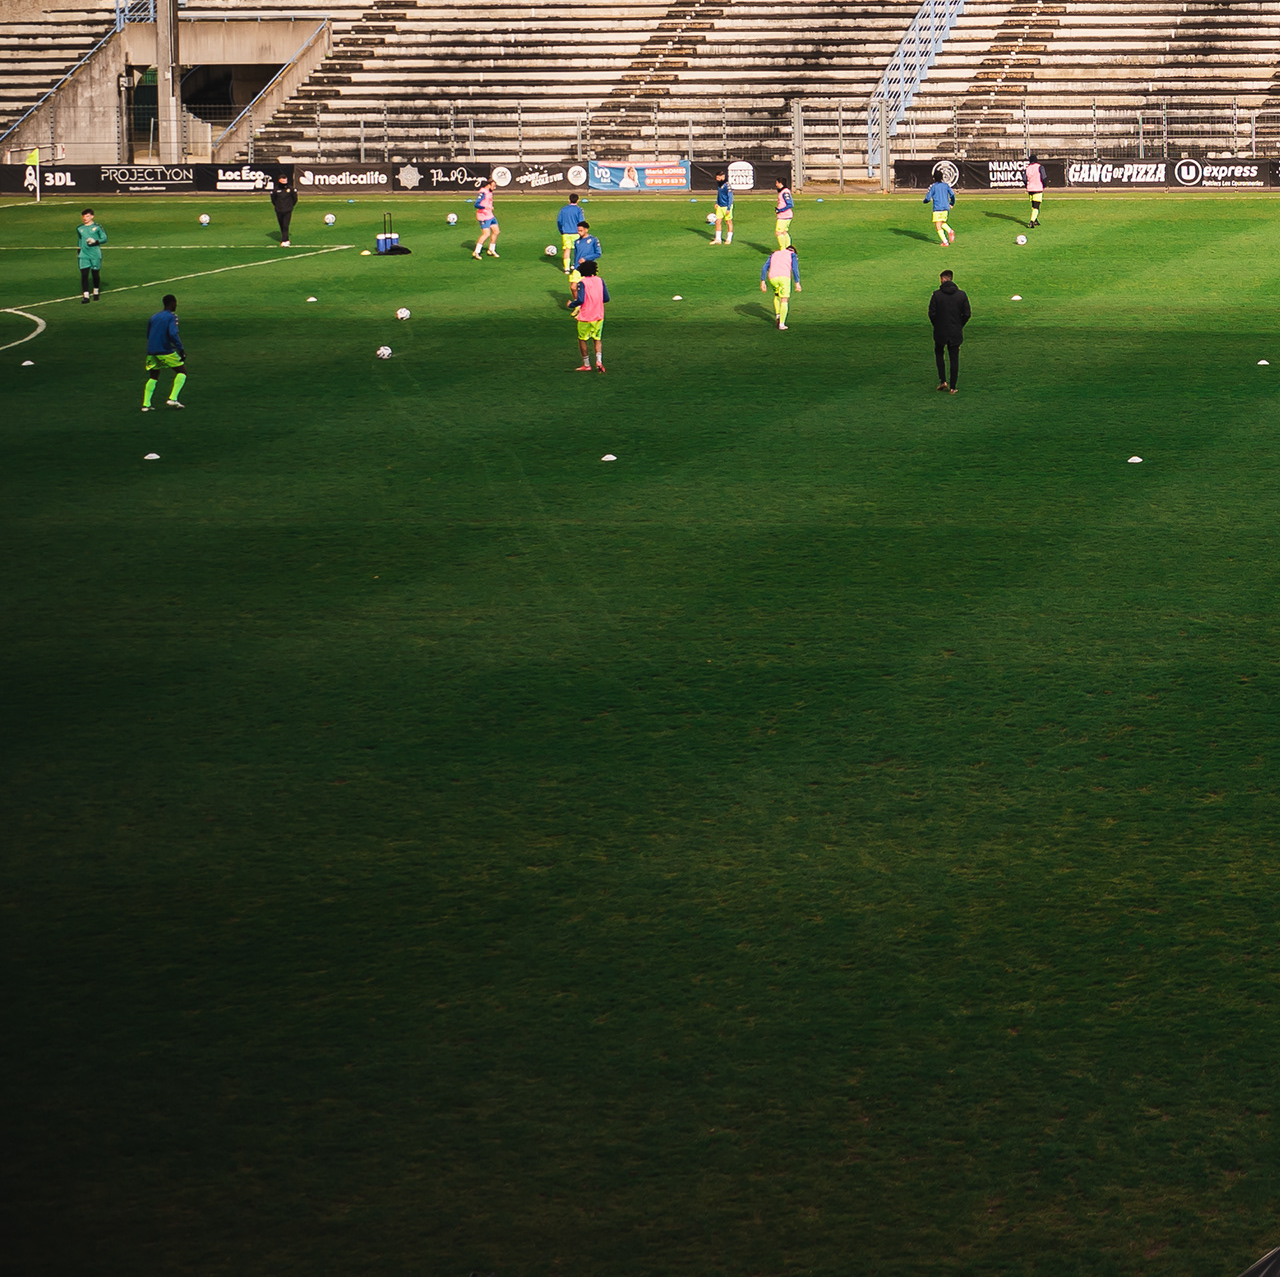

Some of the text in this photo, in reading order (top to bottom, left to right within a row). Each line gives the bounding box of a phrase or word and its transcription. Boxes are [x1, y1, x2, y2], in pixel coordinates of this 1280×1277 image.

[989, 161, 1030, 171] NUANCE
[1069, 163, 1113, 183] GANG
[1123, 163, 1166, 182] PIZZA
[1202, 165, 1258, 180] express
[44, 172, 76, 186] 3DL
[101, 168, 194, 182] PROJECTYON
[218, 169, 241, 181] Loc
[314, 170, 388, 185] medicalife
[729, 175, 754, 185] KING
[989, 171, 1022, 180] UNIKA
